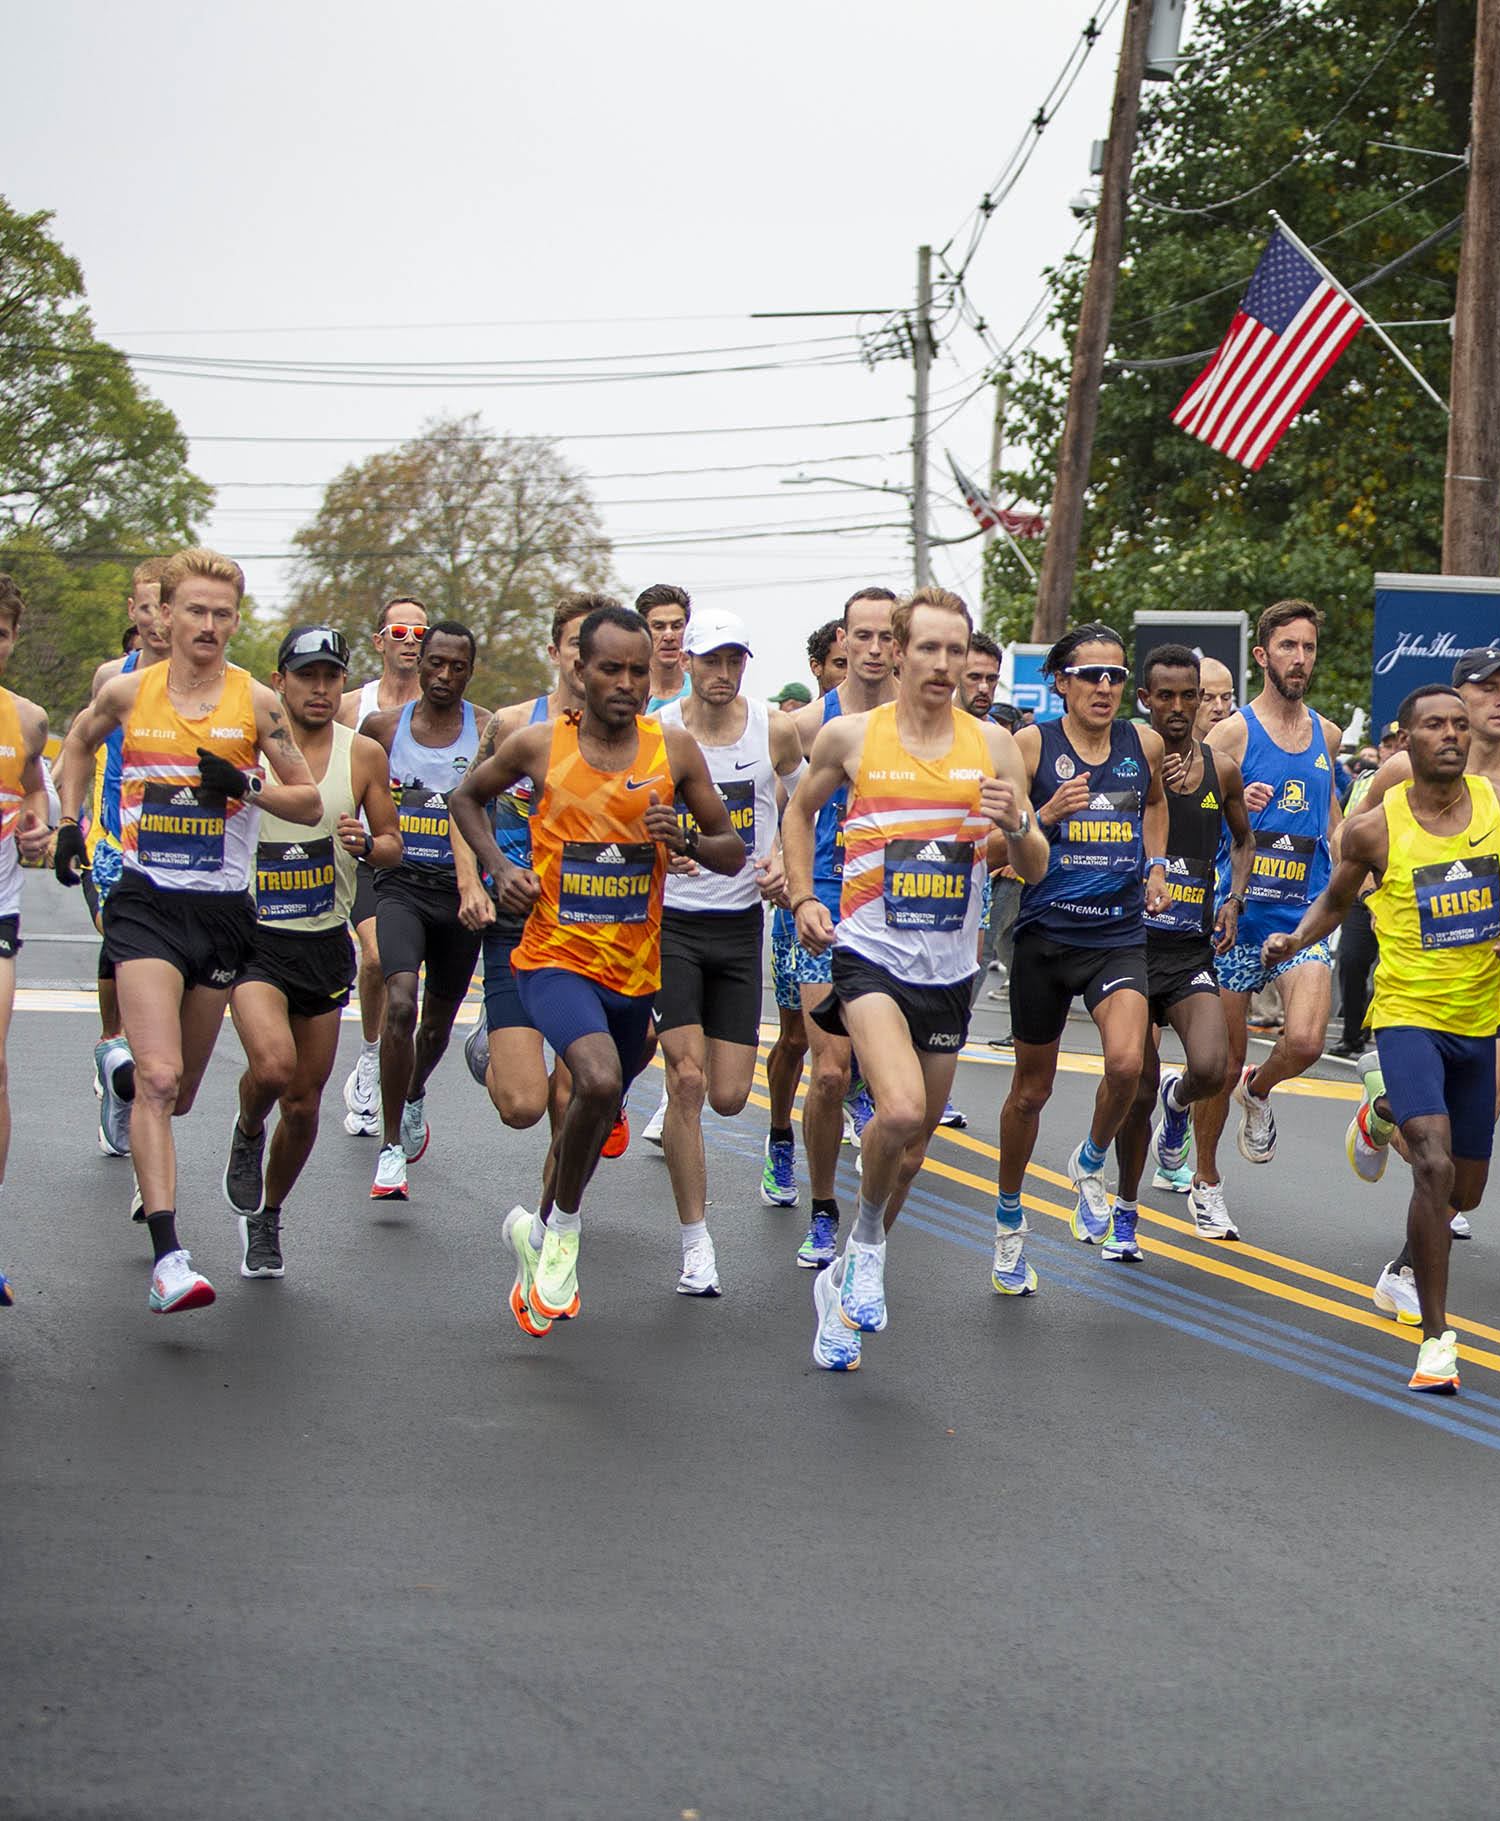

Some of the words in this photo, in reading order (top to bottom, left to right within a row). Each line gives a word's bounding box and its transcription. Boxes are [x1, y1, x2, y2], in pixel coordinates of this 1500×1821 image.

[1375, 632, 1427, 674] John
[210, 727, 244, 739] HOKA
[890, 771, 916, 781] ELITE
[170, 797, 199, 806] adidas
[424, 802, 448, 810] adidas
[1200, 802, 1219, 810] adidas
[140, 813, 224, 836] LINKLETTER
[1068, 820, 1134, 843] RIVERO
[1272, 843, 1295, 851] adidas
[283, 853, 309, 861] adidas
[596, 855, 626, 864] adidas
[916, 854, 946, 862] adidas
[1252, 855, 1307, 881] TAYLOR
[257, 865, 334, 891] TRUJILLO
[1444, 871, 1473, 882] adidas
[562, 873, 651, 897] MENGSTU
[892, 872, 965, 898] FAUBLE
[1430, 886, 1493, 919] LELISA
